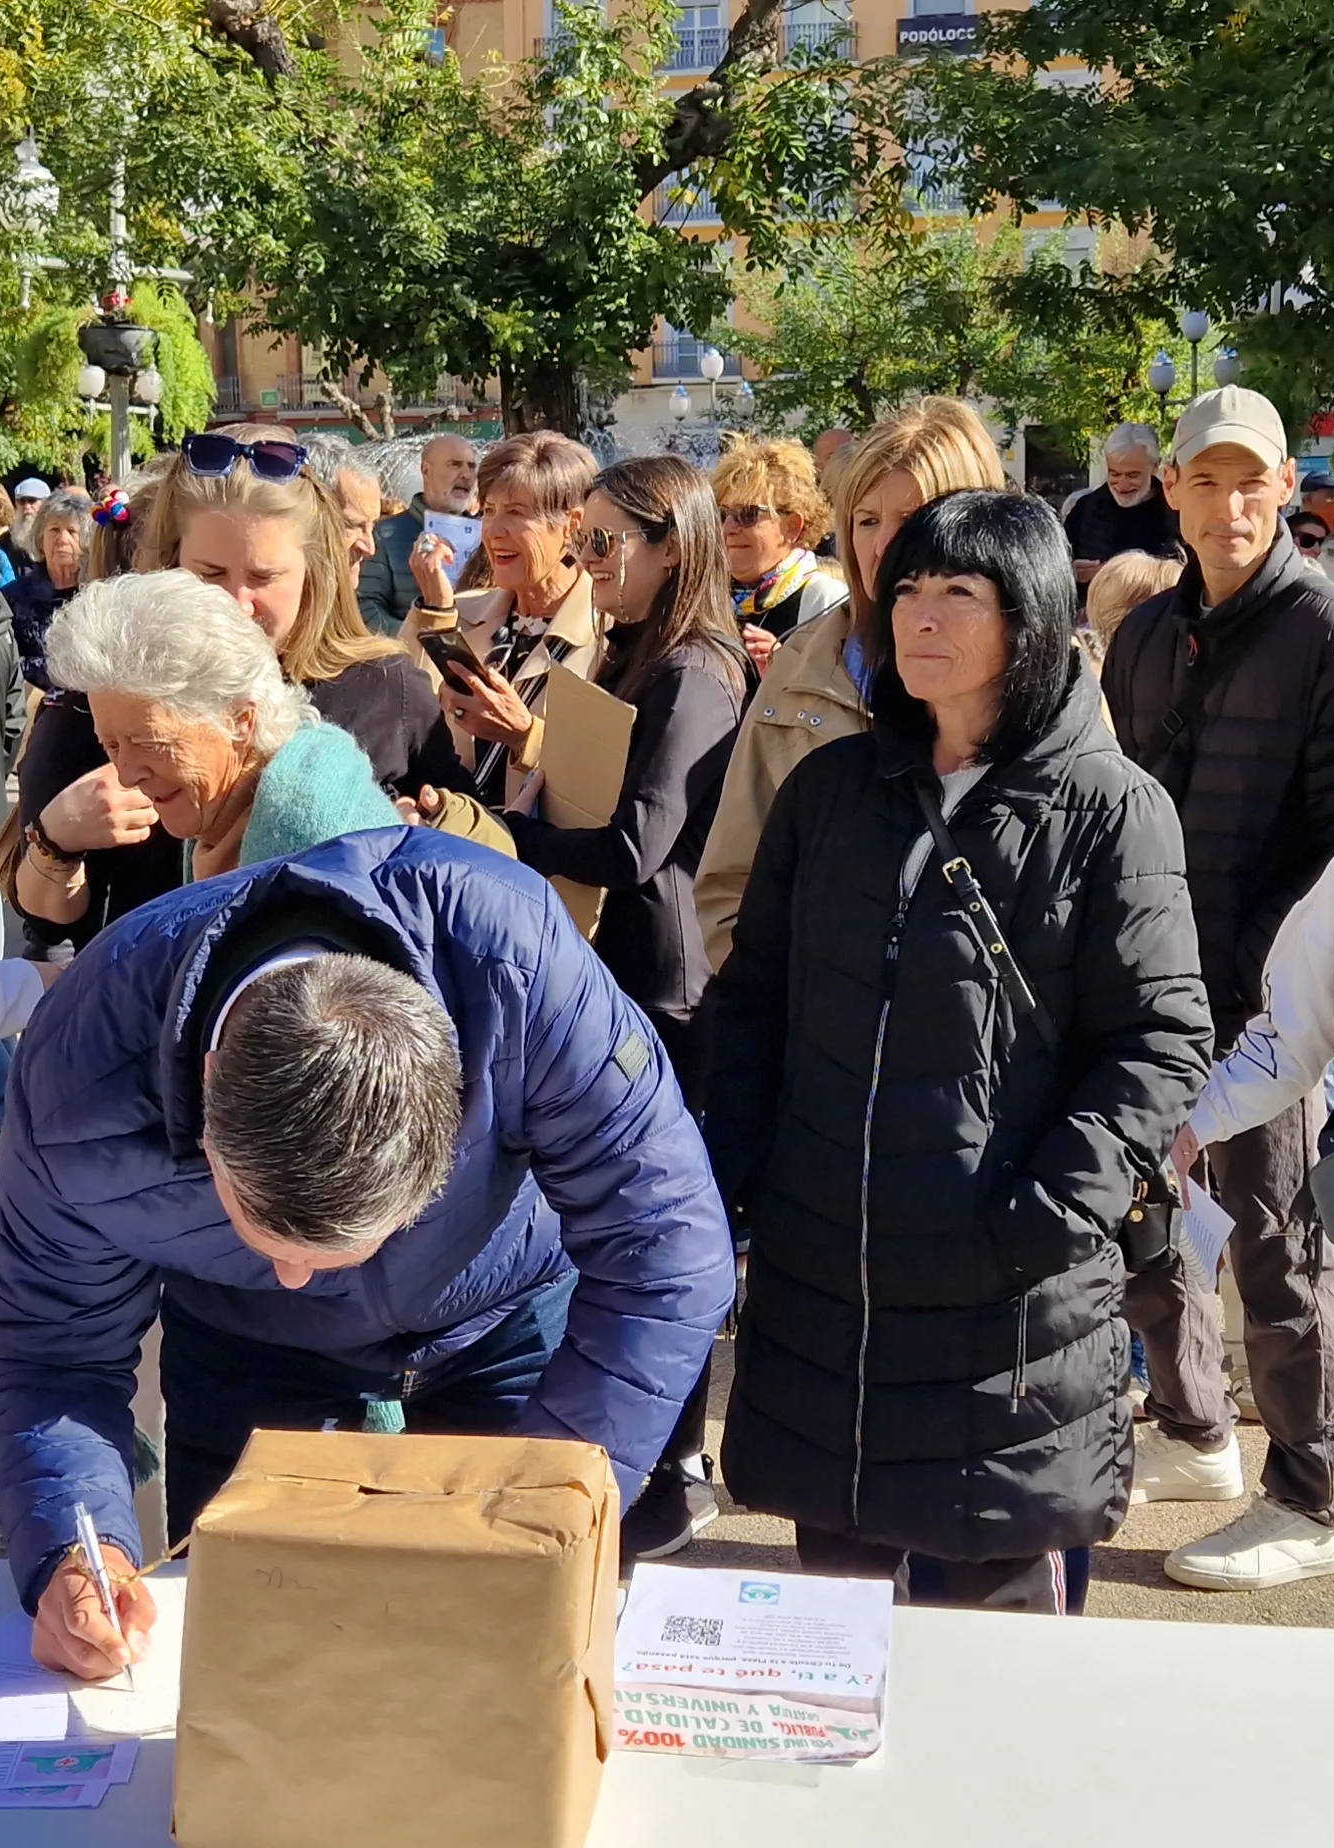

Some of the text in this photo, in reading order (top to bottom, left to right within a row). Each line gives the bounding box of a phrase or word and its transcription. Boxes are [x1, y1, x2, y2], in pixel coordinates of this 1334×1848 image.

[621, 1661, 693, 1673] pasa?
[701, 1667, 725, 1676] te
[733, 1668, 781, 1678] qué
[824, 1672, 838, 1681] a
[846, 1673, 874, 1685] ¿Y
[747, 1703, 760, 1716] Y
[738, 1719, 763, 1733] DE
[617, 1728, 686, 1747] 100%
[692, 1734, 781, 1749] SANIDAD
